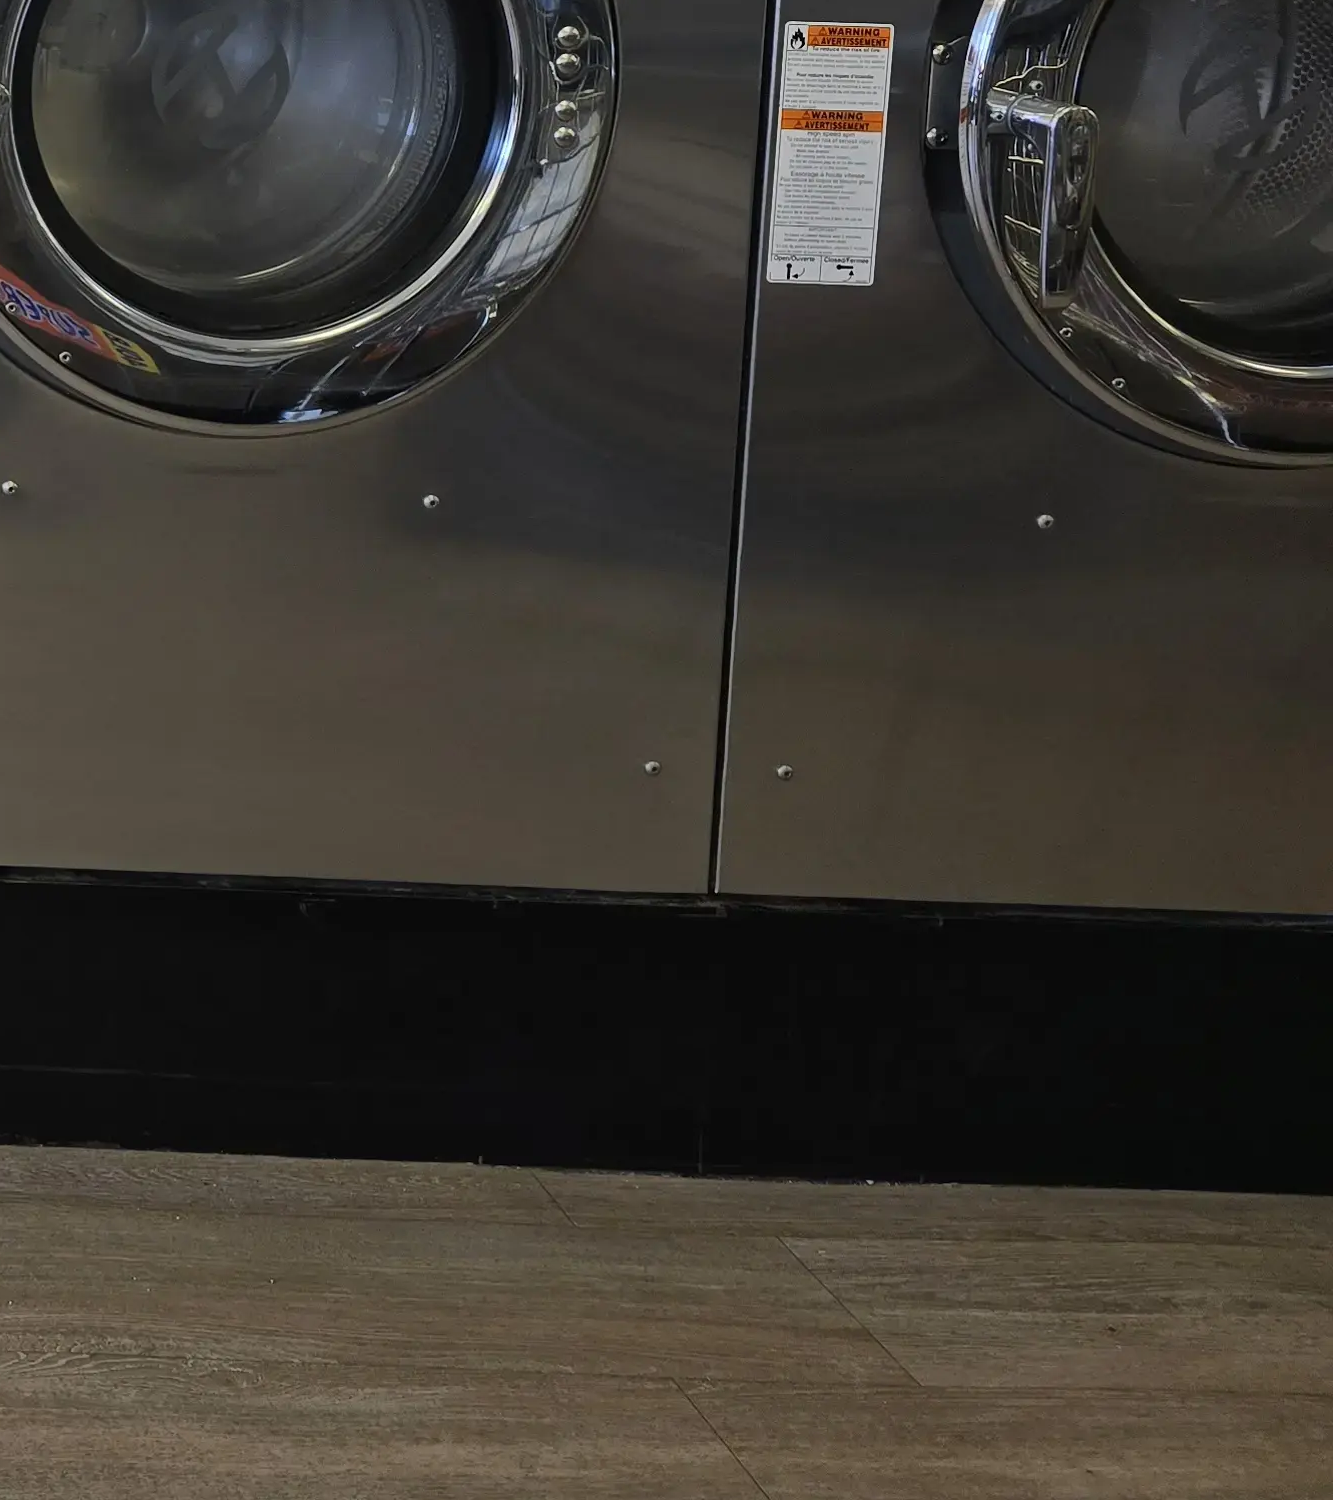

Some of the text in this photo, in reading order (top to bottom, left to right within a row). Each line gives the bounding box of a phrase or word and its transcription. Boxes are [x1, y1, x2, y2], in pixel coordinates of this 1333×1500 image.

[828, 27, 880, 37] WARNING
[821, 37, 887, 47] AVERTISSEMENT
[812, 111, 863, 120] WARNING
[805, 121, 870, 130] AVERTISSEMENT
